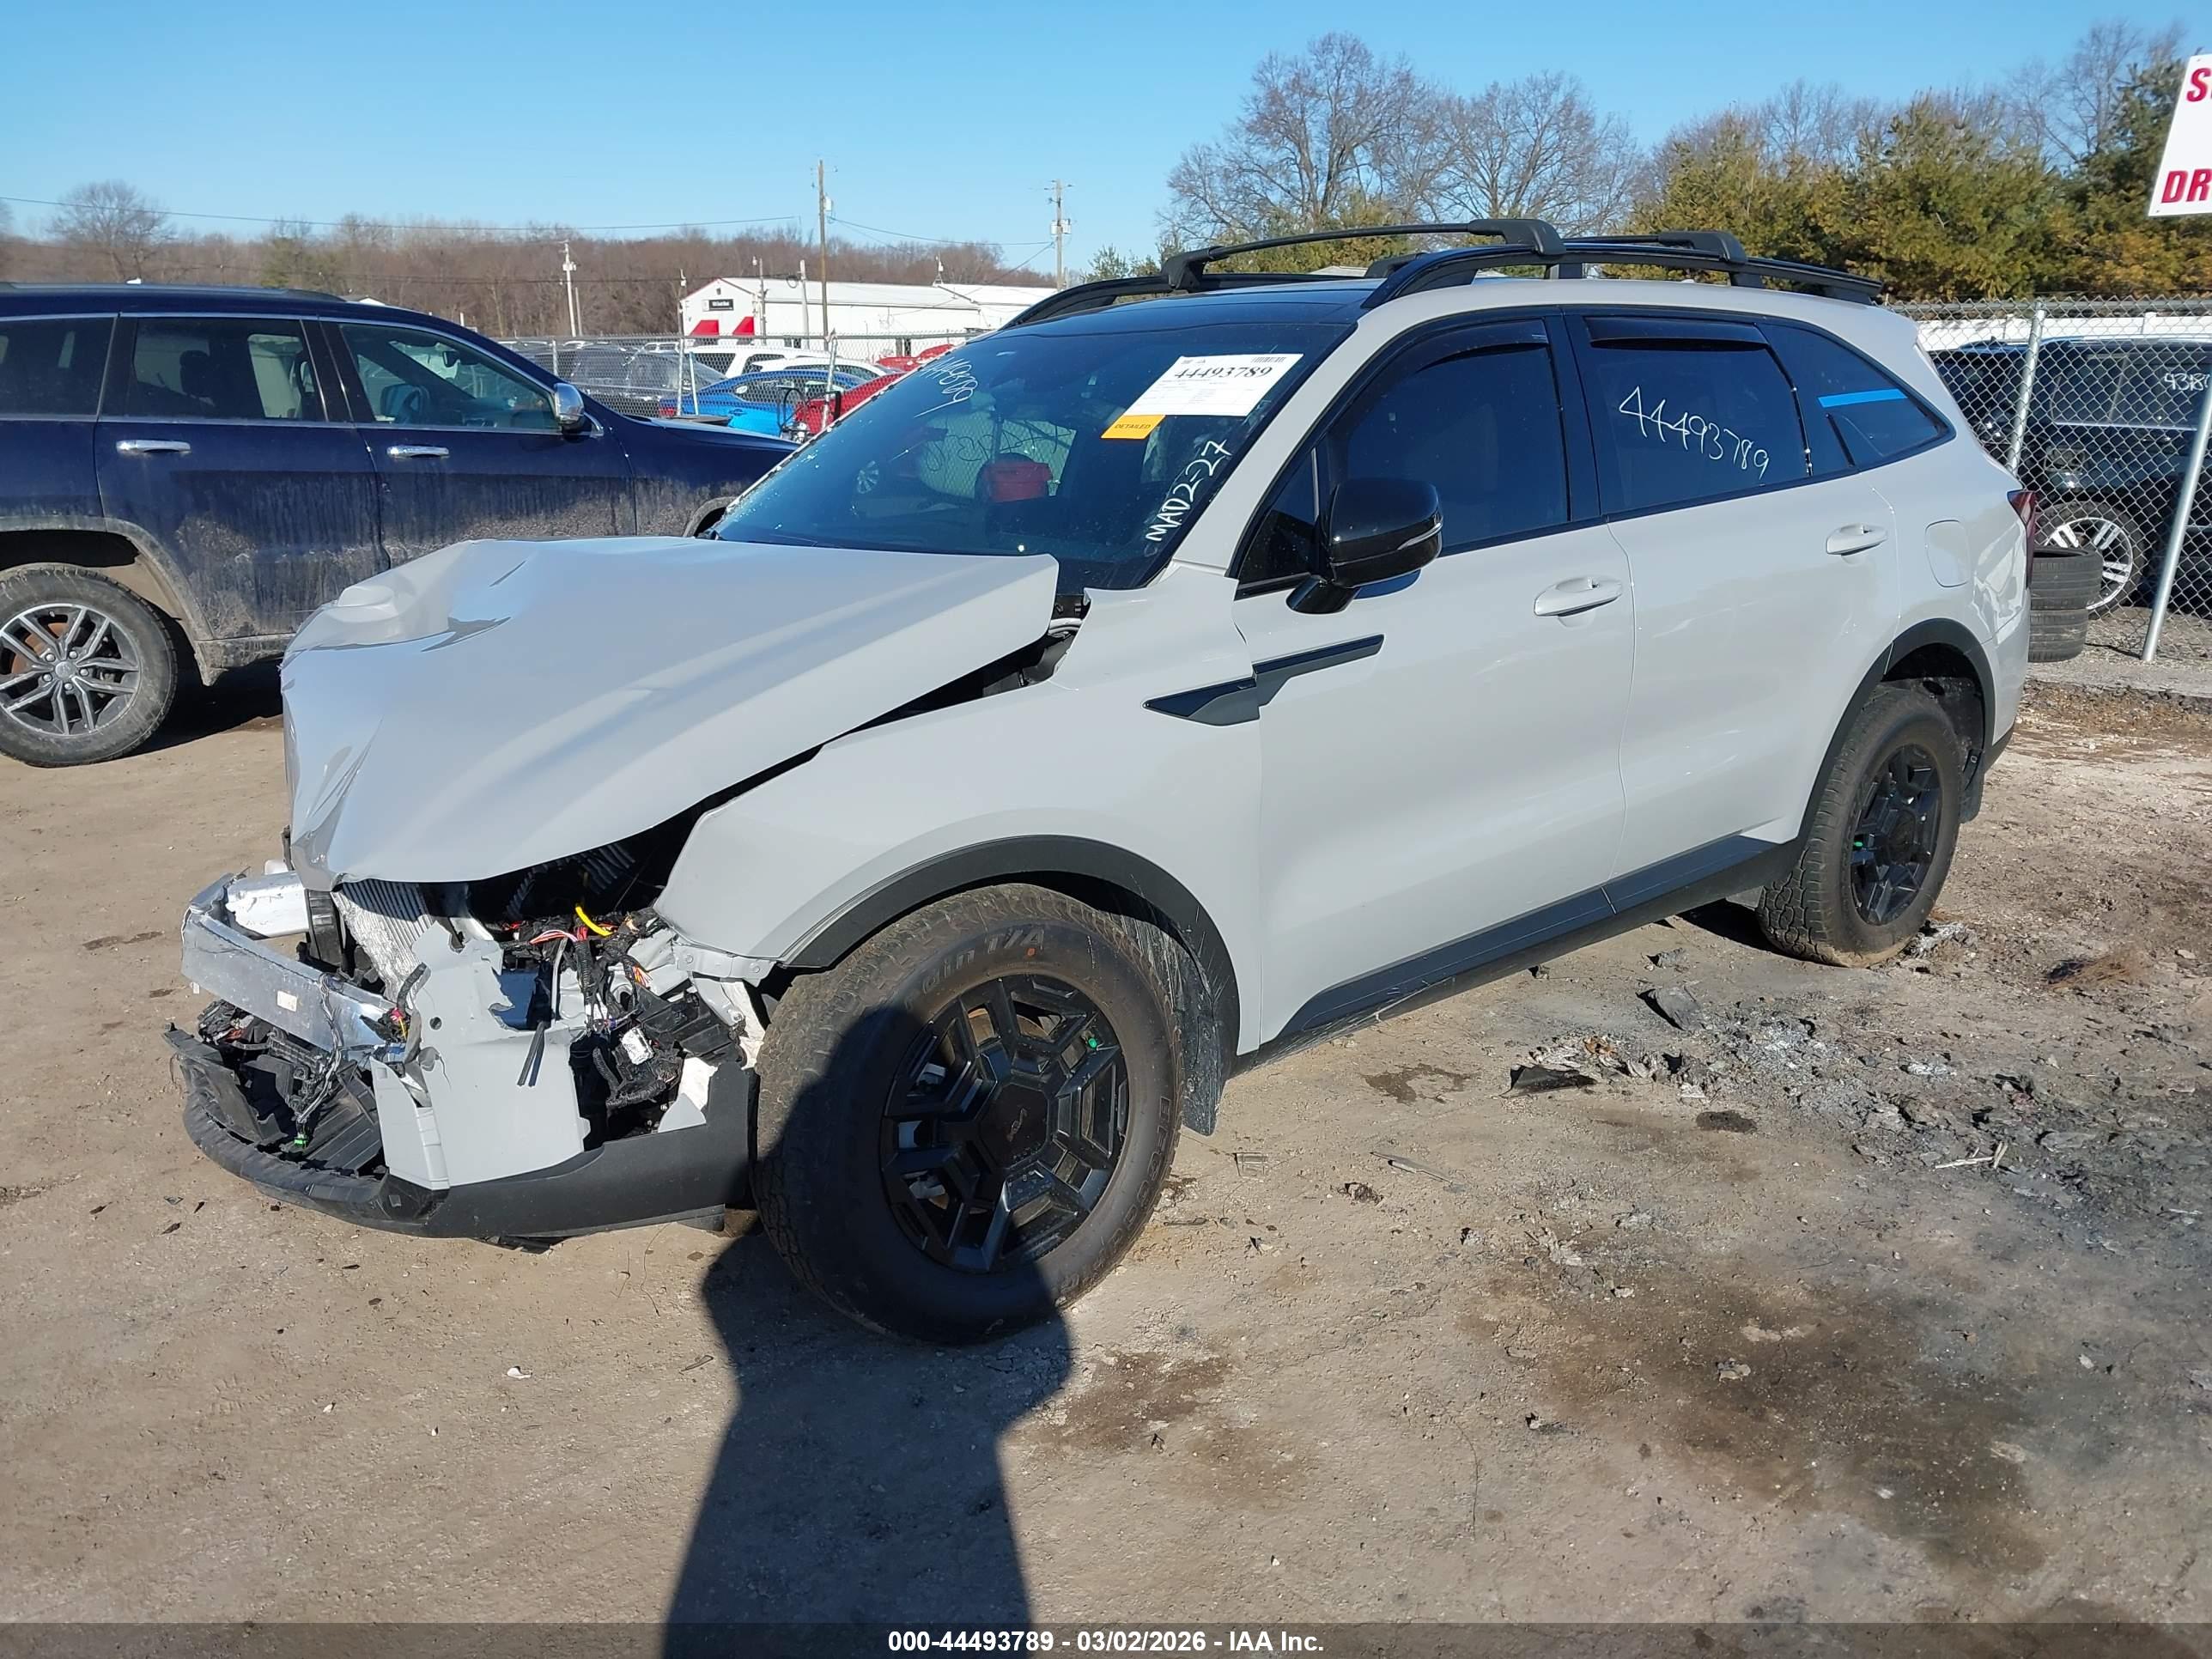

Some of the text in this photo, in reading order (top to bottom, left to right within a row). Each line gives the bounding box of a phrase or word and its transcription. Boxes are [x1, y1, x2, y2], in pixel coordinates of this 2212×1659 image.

[2186, 68, 2212, 102] S
[1175, 367, 1273, 379] 44493789
[1620, 386, 1769, 480] 44493789
